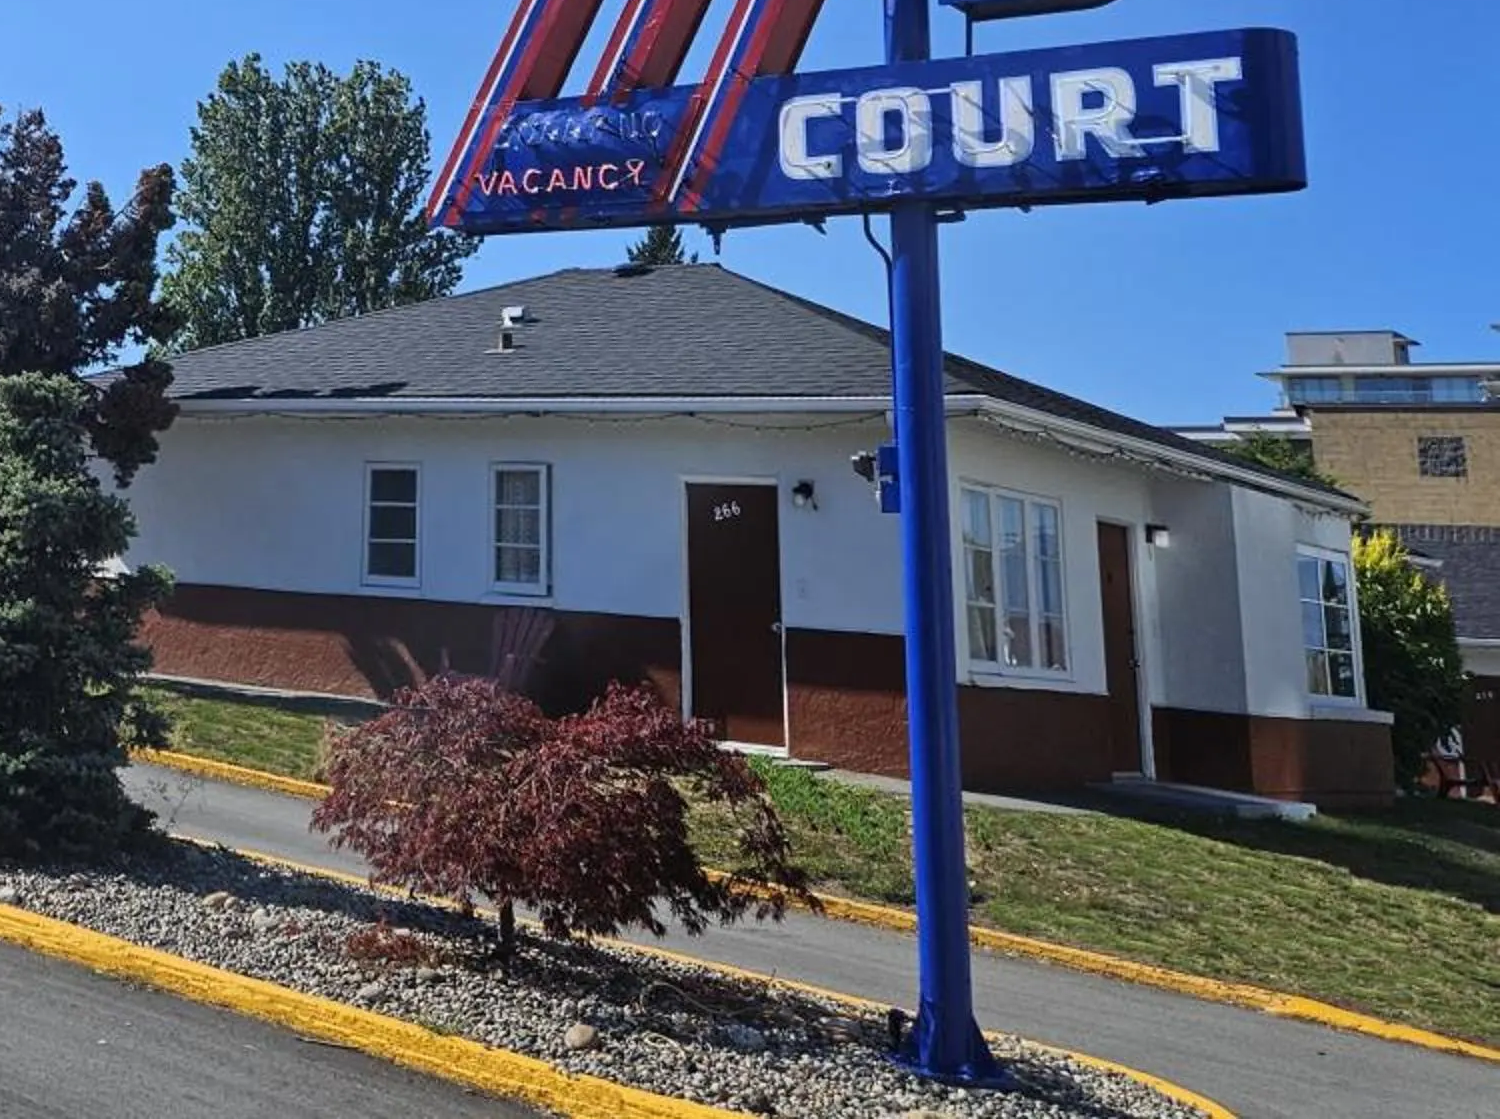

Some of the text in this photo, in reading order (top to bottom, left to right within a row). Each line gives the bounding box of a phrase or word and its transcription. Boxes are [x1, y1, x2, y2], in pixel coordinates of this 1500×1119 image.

[779, 57, 1242, 180] COURT
[476, 158, 645, 195] VACANCY
[713, 500, 741, 520] 266
